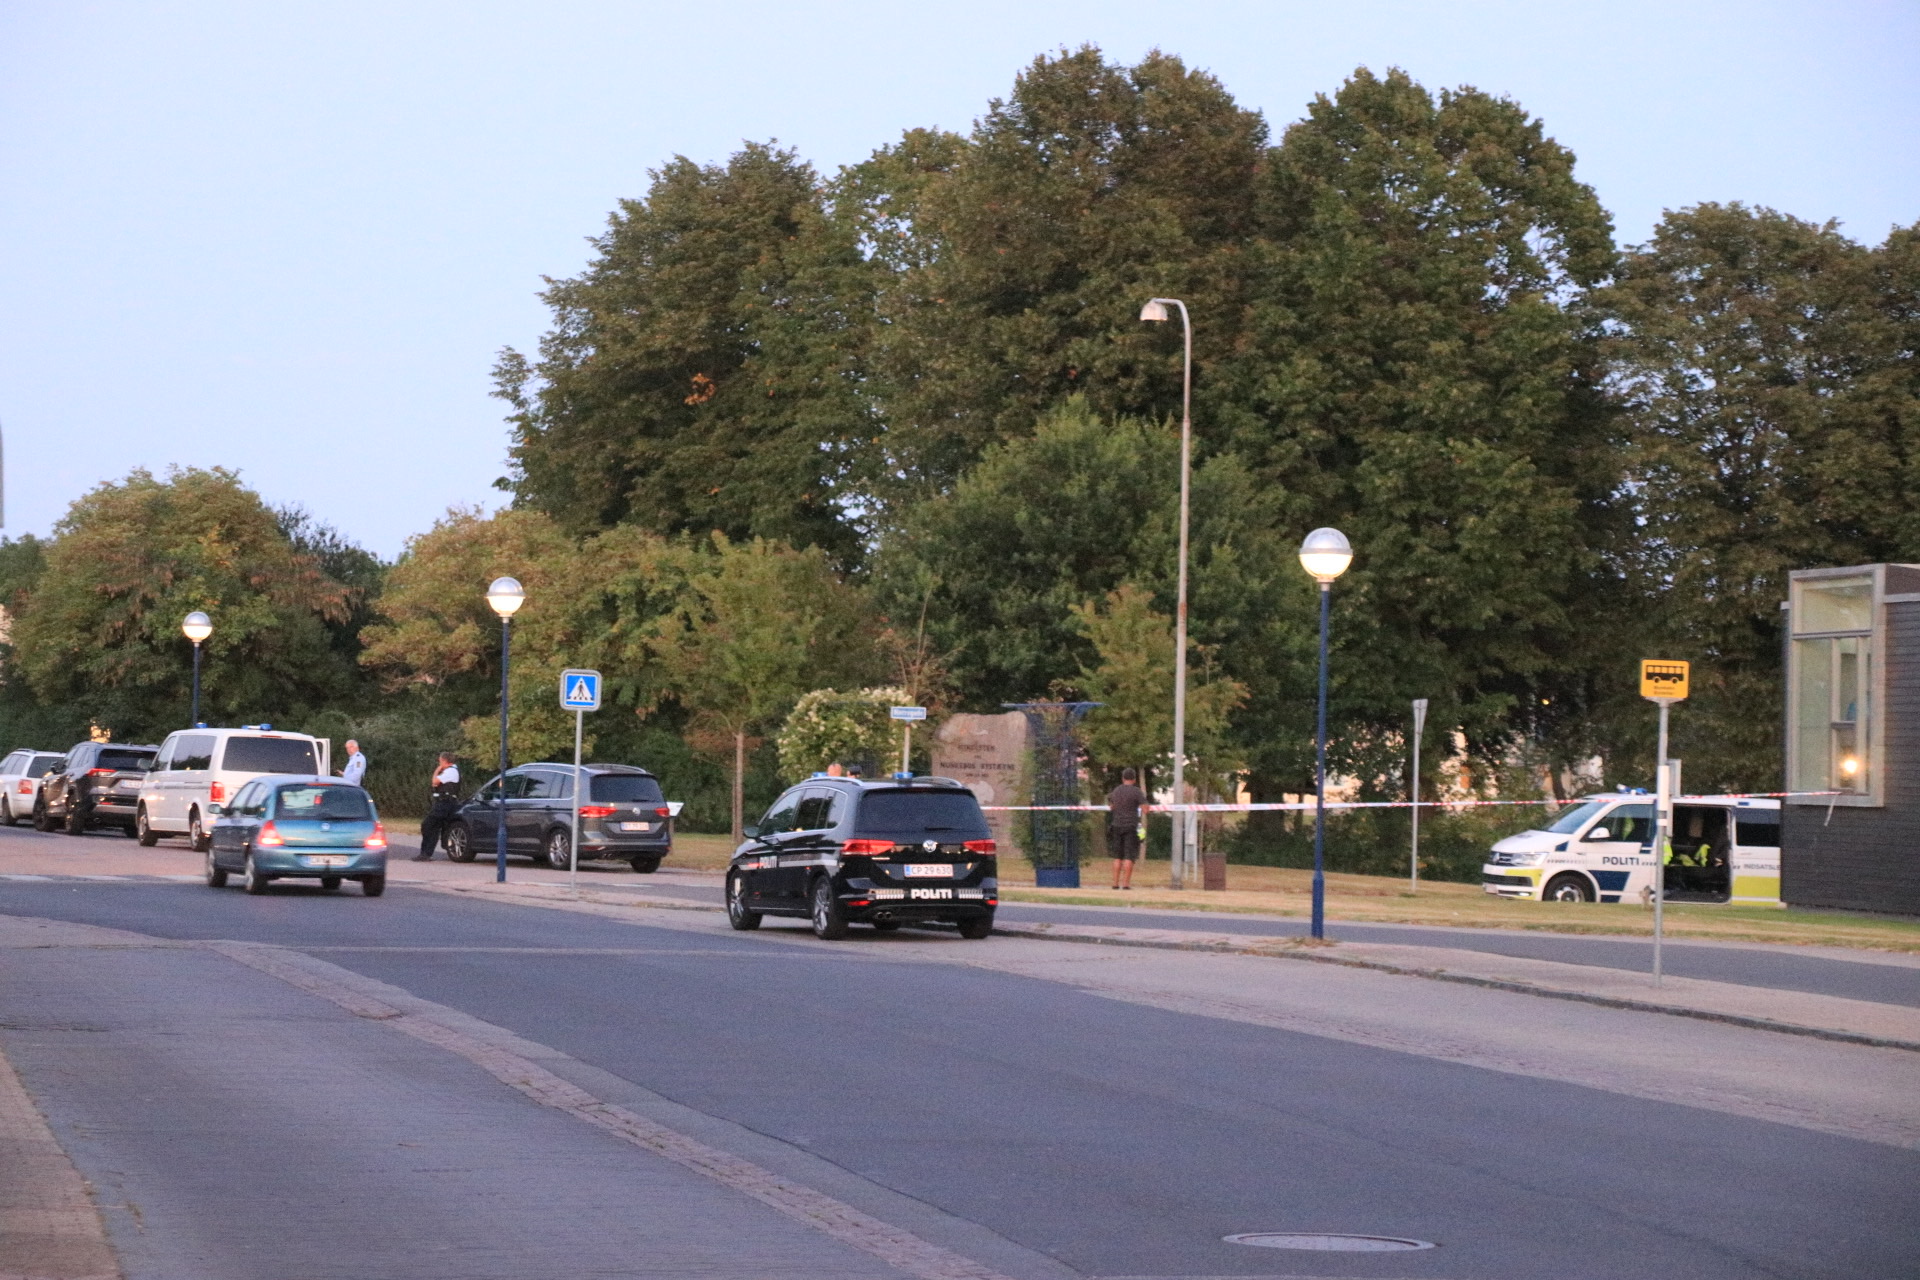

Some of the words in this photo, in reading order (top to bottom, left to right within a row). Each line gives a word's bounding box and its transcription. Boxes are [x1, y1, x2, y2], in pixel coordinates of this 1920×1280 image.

[1602, 856, 1640, 866] POLITI
[911, 866, 922, 874] CP
[924, 866, 935, 874] 29
[936, 866, 952, 874] 630
[910, 888, 953, 900] POLITI
